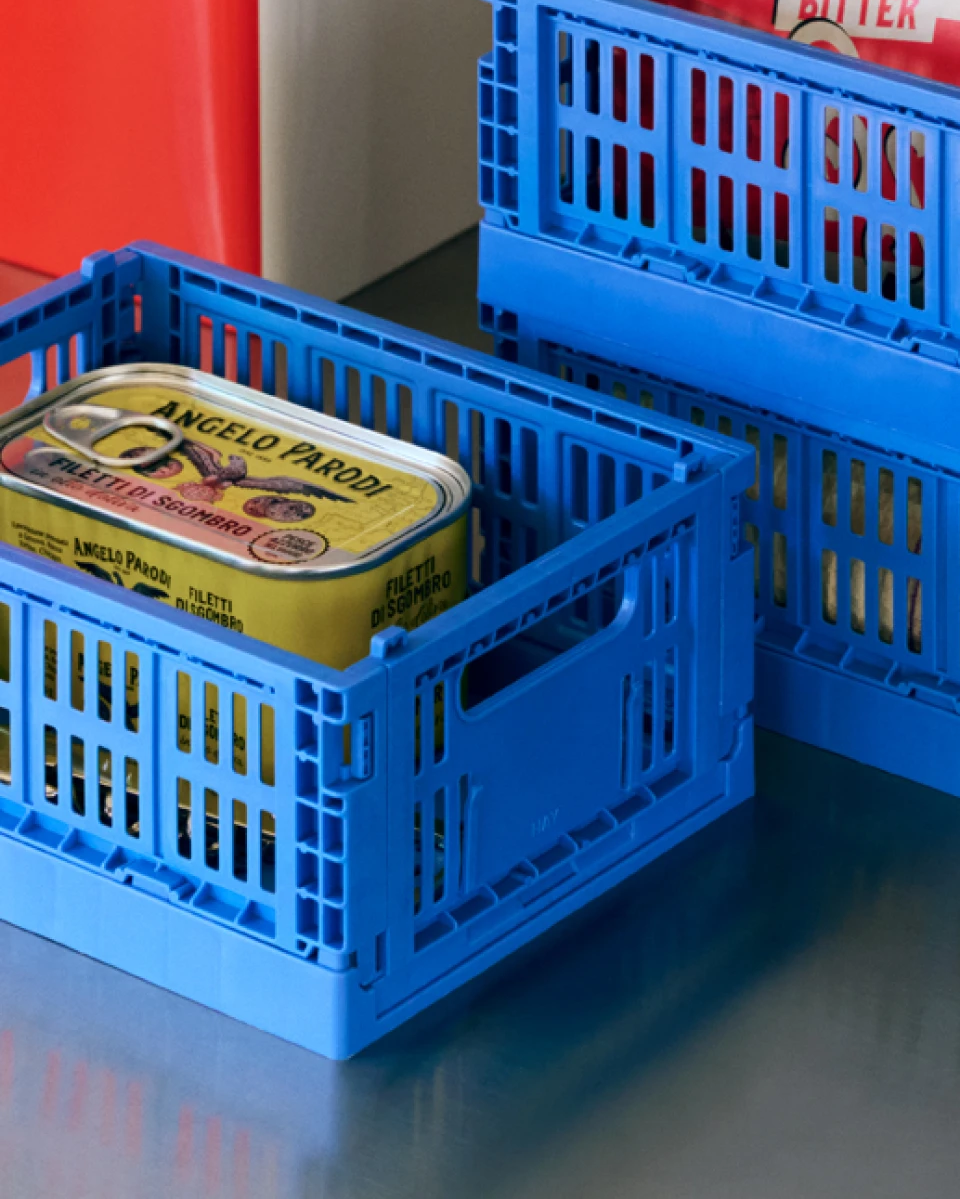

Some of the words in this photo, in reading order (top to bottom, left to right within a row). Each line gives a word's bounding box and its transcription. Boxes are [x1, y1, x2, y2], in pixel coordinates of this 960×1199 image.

[150, 400, 281, 452] ANGELO
[278, 441, 394, 498] PARODI
[48, 457, 132, 491] FILETTI
[127, 485, 156, 501] DI
[152, 495, 253, 537] SGOMBRO
[74, 537, 123, 565] ANGELO
[125, 551, 172, 590] PARODI
[386, 556, 435, 598] FILETTI
[188, 586, 233, 613] FILETTI
[371, 605, 385, 629] DI
[387, 570, 452, 619] SGOMBRO
